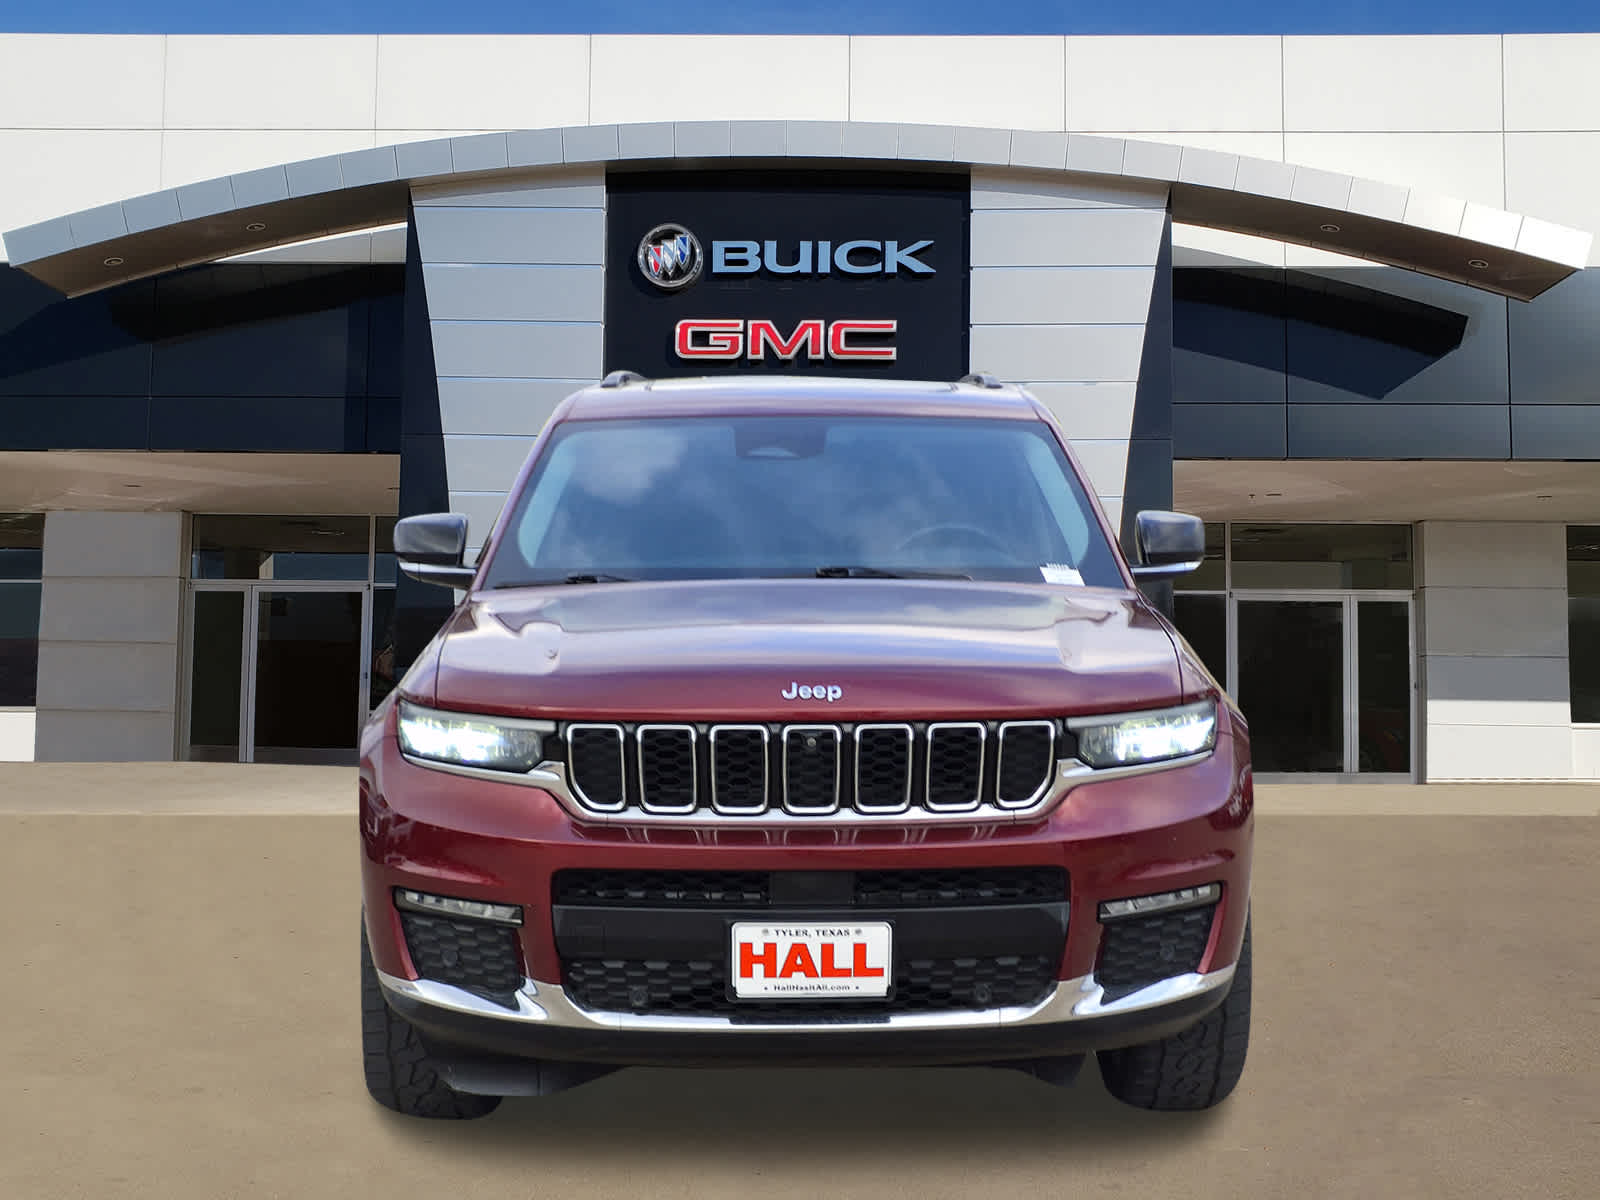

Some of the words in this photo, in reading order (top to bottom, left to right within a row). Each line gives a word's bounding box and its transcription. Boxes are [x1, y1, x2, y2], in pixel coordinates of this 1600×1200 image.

[711, 240, 936, 273] BUICK
[675, 319, 897, 360] GMC
[781, 681, 842, 703] Jeep
[774, 929, 812, 938] TYLER,
[815, 929, 850, 937] TEXAS
[739, 942, 885, 978] HALL
[773, 984, 850, 992] HallHasItAll.com
